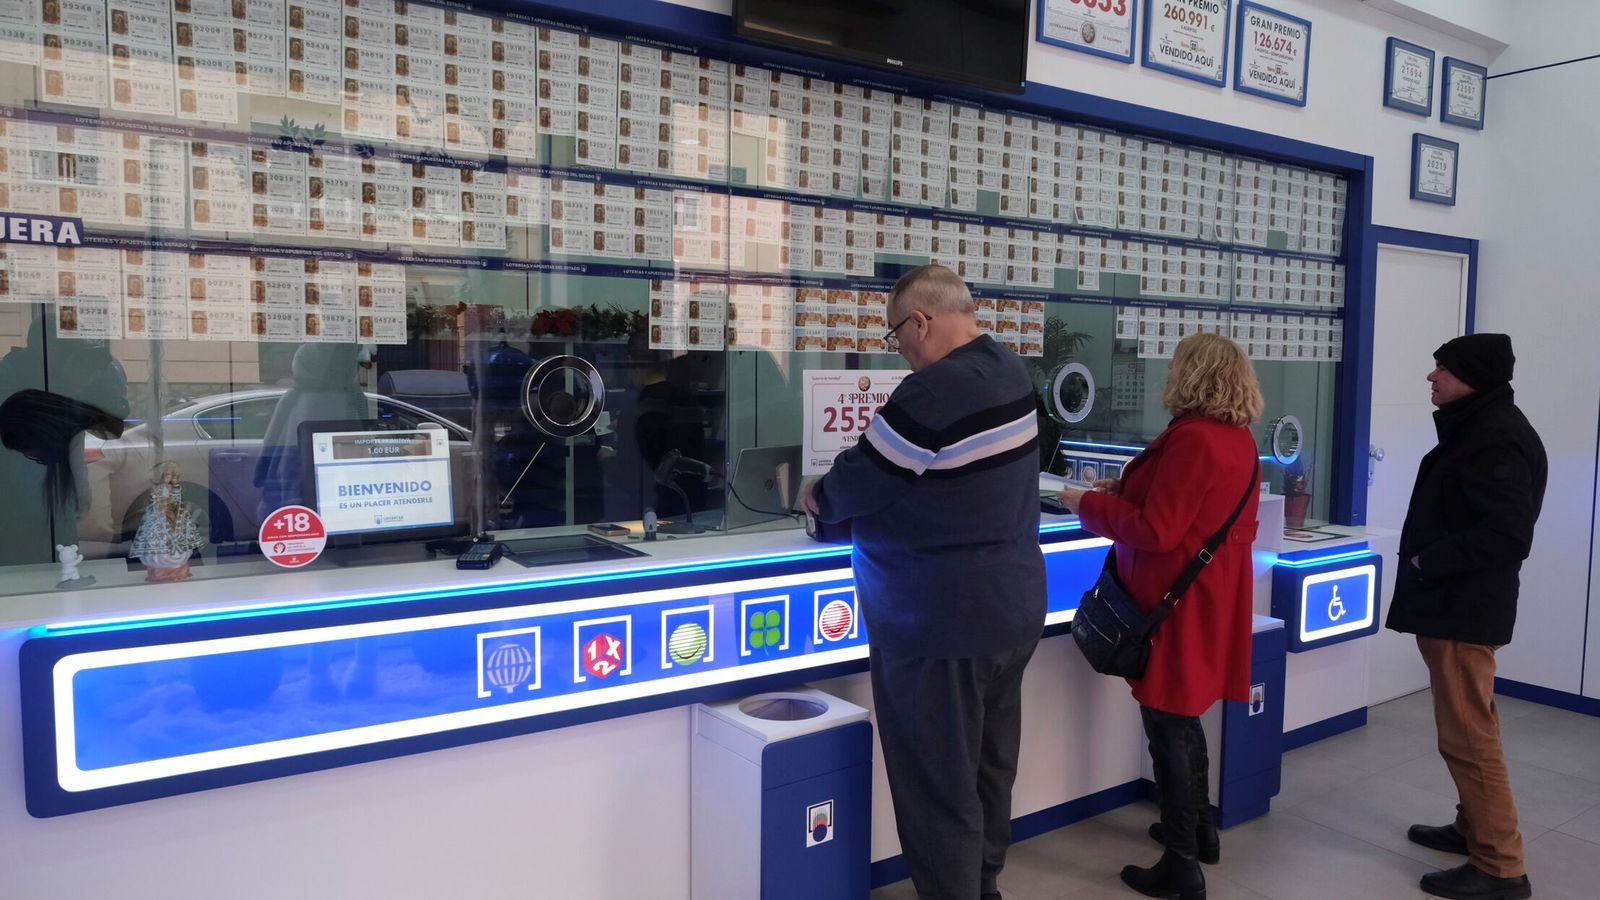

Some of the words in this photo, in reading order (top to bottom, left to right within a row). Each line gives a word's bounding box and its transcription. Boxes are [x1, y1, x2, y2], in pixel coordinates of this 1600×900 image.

[1164, 3, 1207, 30] 260.991
[1250, 15, 1273, 31] GRAN
[1274, 23, 1300, 40] PREMIO
[1254, 30, 1292, 54] 126.674
[1160, 44, 1193, 61] VENDIDO
[1195, 55, 1214, 68] AQUÍ
[1249, 68, 1278, 84] VENDIDO
[1279, 77, 1296, 89] AQUÍ
[849, 393, 890, 404] PREMIO
[823, 406, 882, 433] 255
[368, 447, 383, 455] 1,00
[338, 480, 432, 497] BIENVENIDO
[394, 497, 432, 505] ATENDERLE
[273, 512, 310, 532] +18
